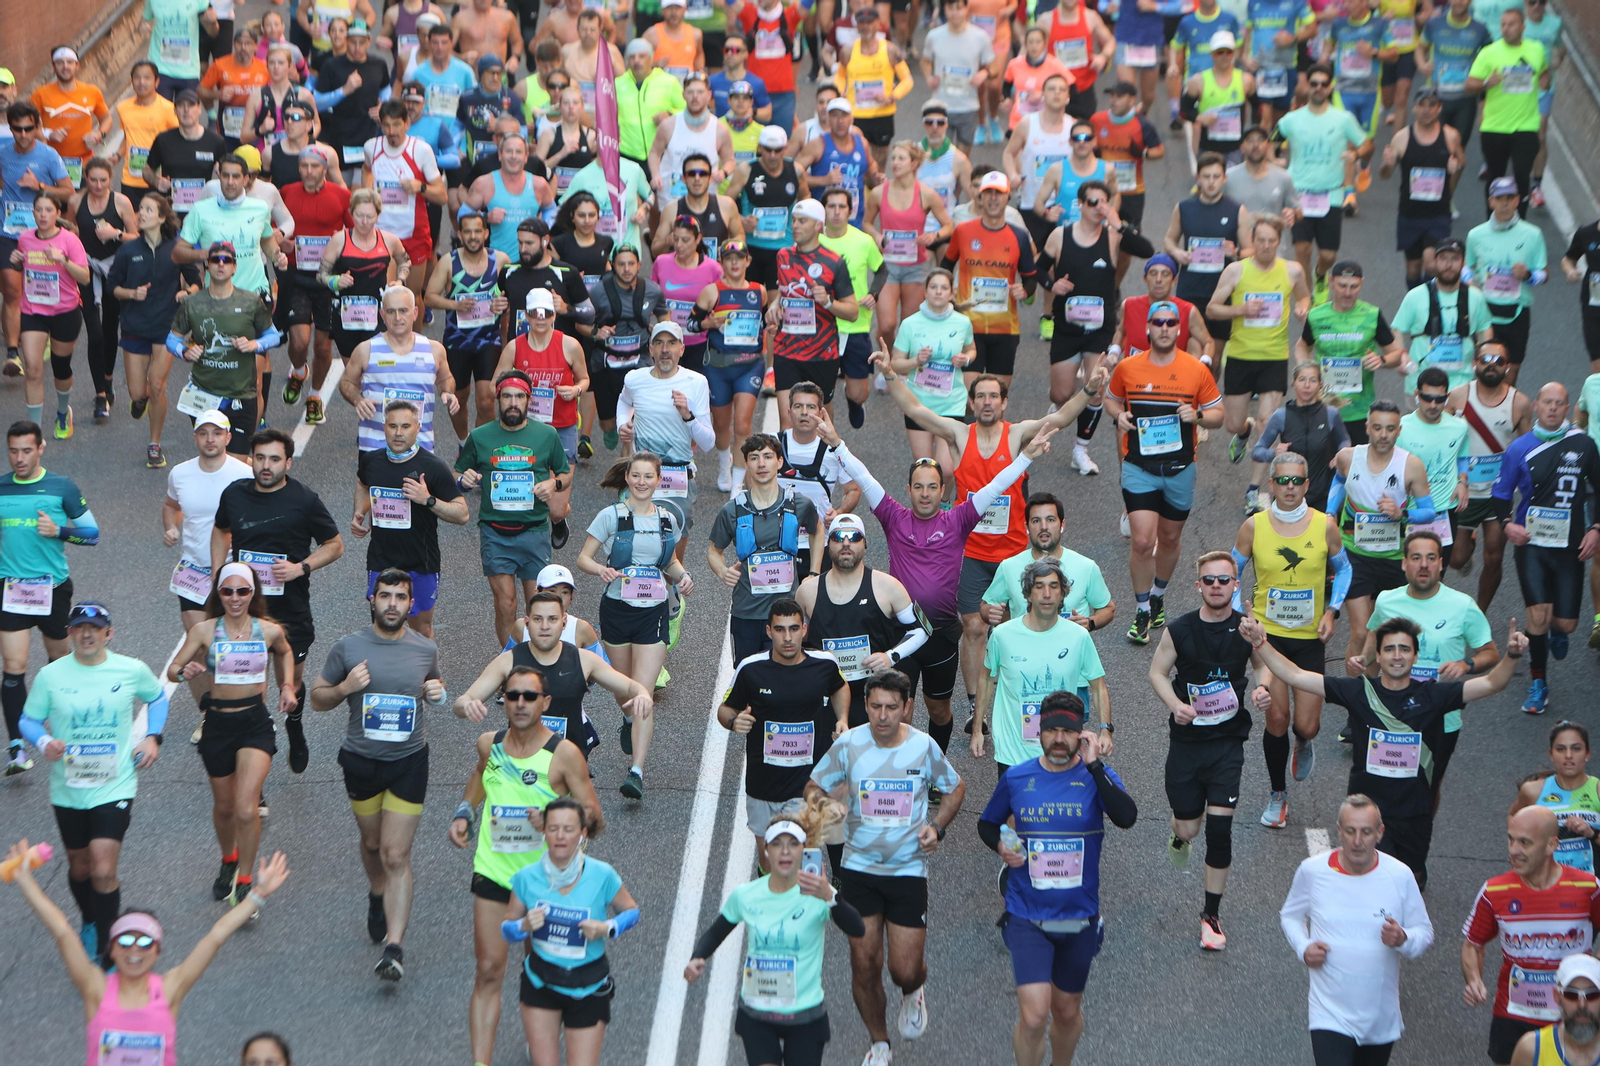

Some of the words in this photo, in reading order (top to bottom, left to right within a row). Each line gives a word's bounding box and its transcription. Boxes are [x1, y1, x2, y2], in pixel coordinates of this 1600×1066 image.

[202, 359, 240, 370] TROTONES
[930, 363, 952, 371] ZURICH
[398, 392, 421, 400] ZURICH
[1152, 416, 1174, 426] ZURICH
[505, 472, 528, 480] ZURICH
[382, 504, 396, 512] 8140
[764, 552, 788, 562] ZURICH
[192, 562, 211, 575] ZURIC
[234, 644, 260, 652] ZURICH
[838, 640, 863, 648] ZURICH
[838, 655, 856, 663] 10922
[1411, 668, 1433, 676] URICH
[1201, 682, 1226, 695] ZURICH
[382, 697, 410, 706] ZURICH
[1204, 699, 1220, 708] 8267
[541, 719, 560, 728] RICH
[1387, 735, 1414, 744] ZURICH
[878, 782, 908, 790] ZURICH
[1020, 807, 1082, 816] FUENTES
[1048, 842, 1076, 852] ZURICH
[552, 907, 583, 920] ZURICH
[548, 924, 570, 935] 11727
[758, 960, 788, 970] ZURICH
